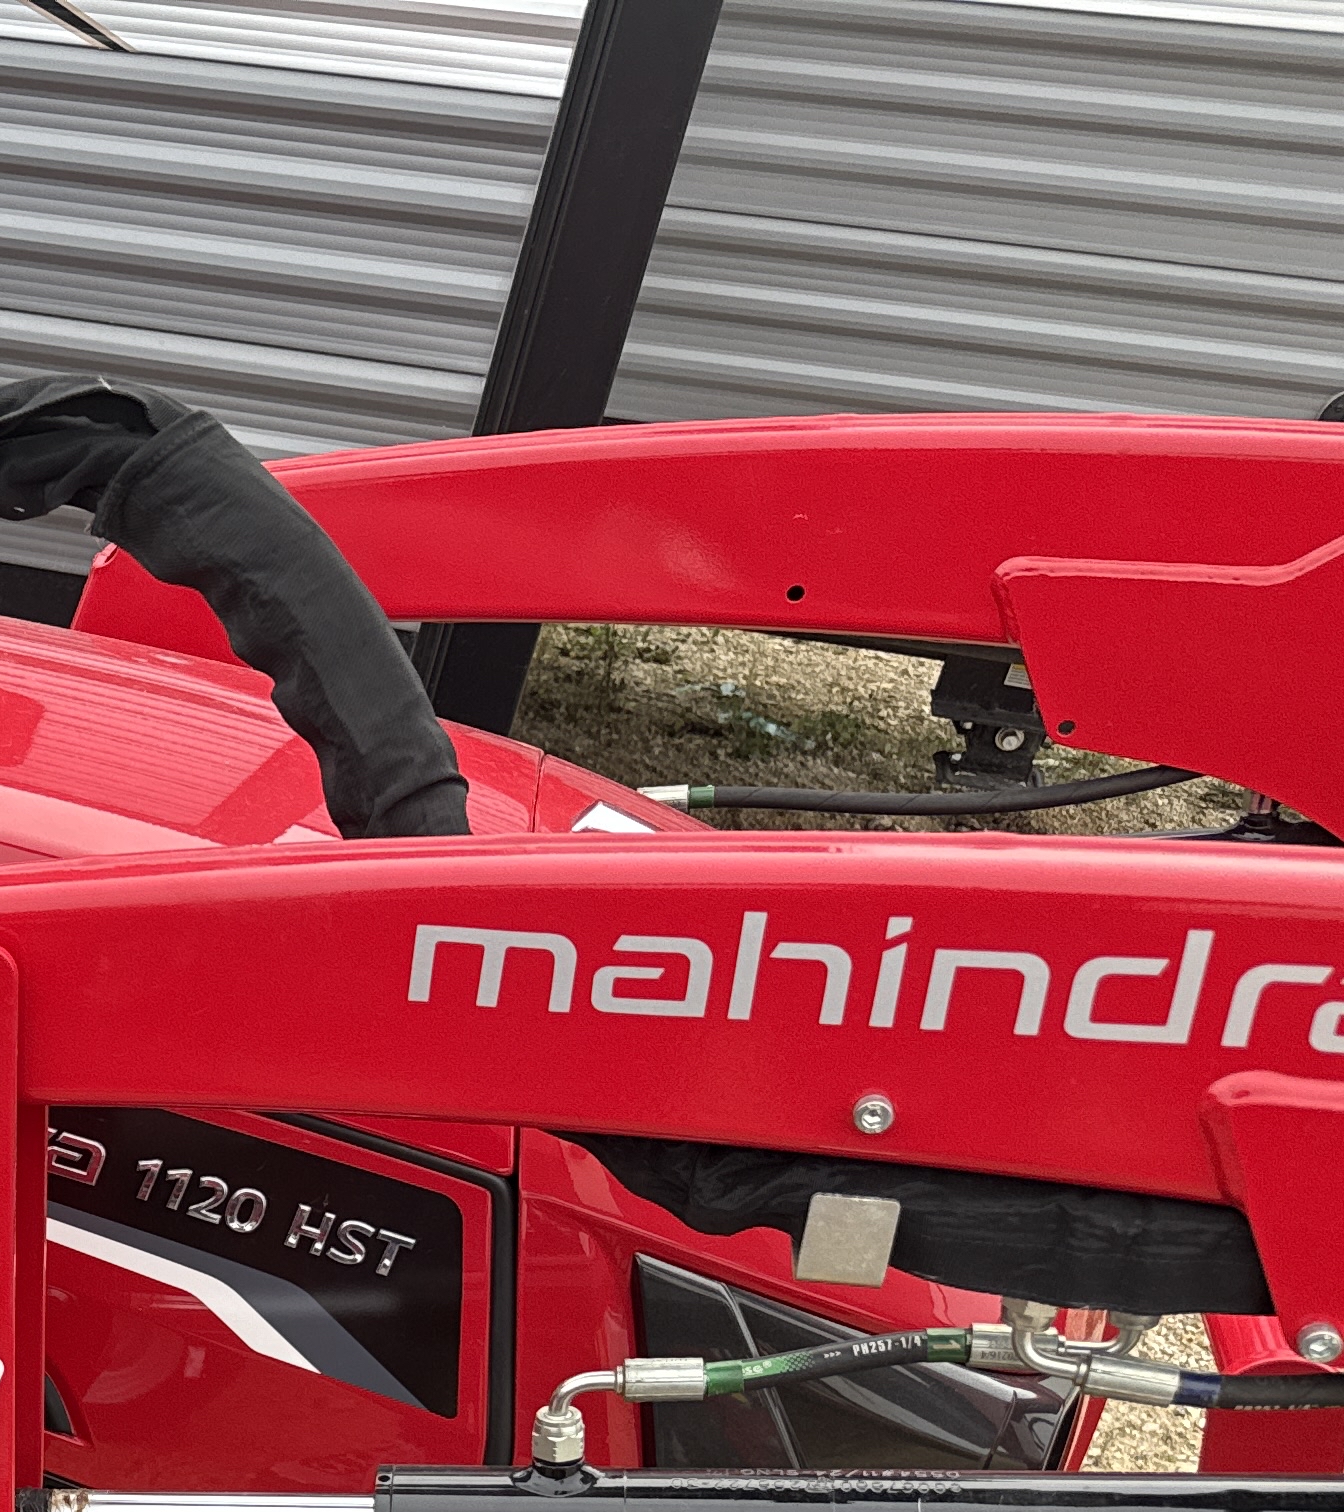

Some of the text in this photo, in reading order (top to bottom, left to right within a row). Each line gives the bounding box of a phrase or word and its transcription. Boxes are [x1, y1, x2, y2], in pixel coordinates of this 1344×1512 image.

[408, 911, 1344, 1054] mahindr
[136, 1158, 416, 1277] 1120 HST
